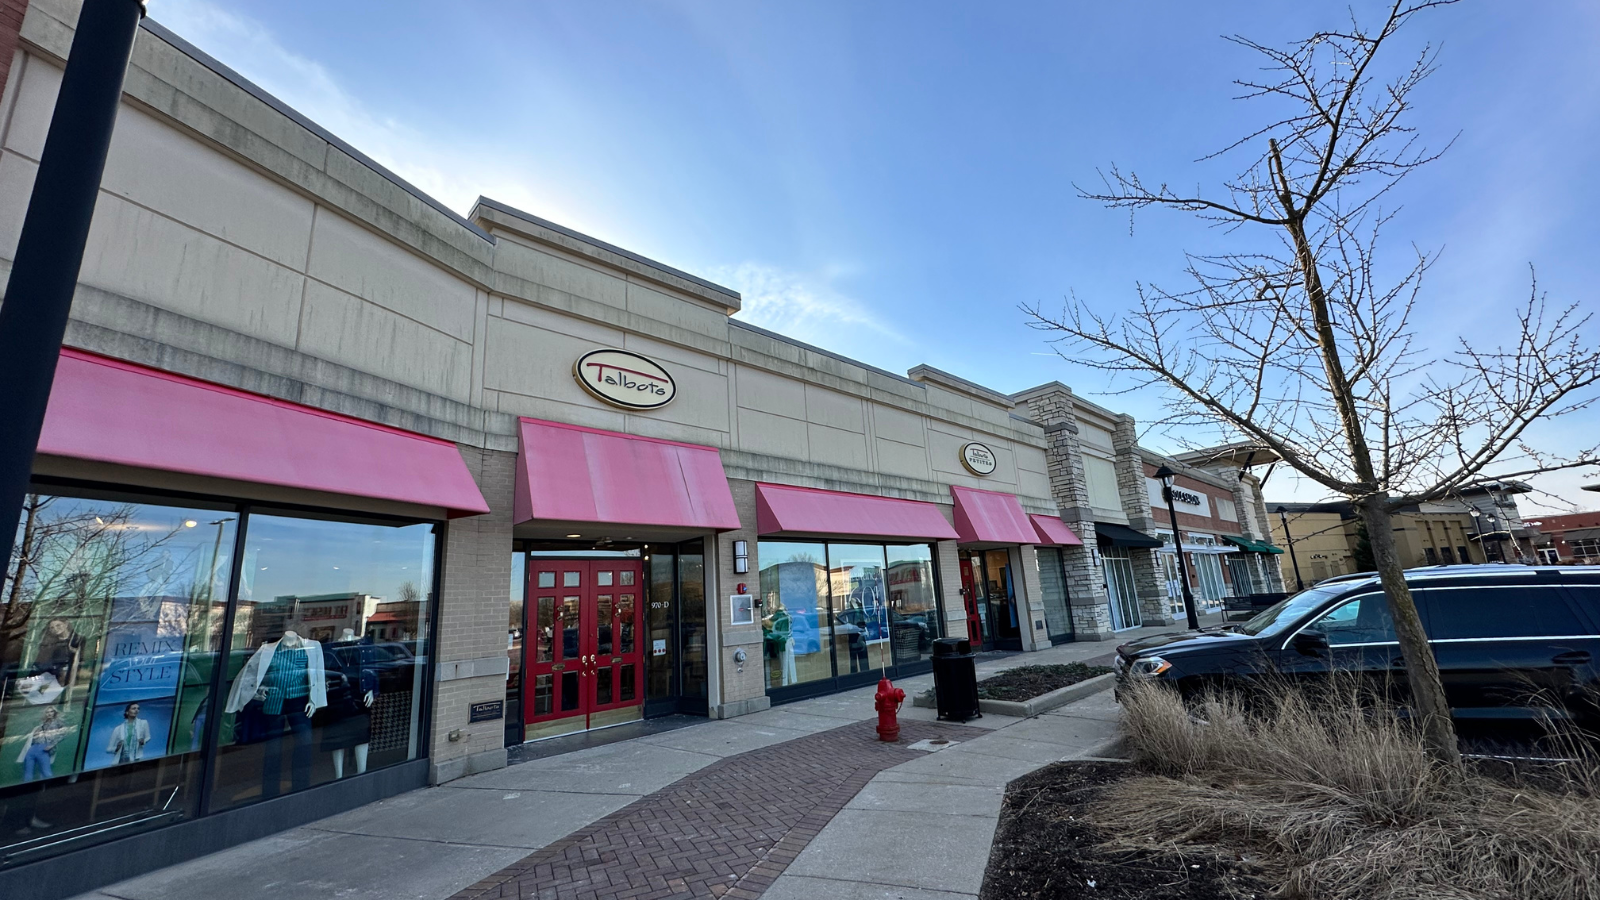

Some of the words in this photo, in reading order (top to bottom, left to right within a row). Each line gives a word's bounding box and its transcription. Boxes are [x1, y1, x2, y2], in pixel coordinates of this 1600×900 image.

[586, 362, 669, 396] Talbots
[969, 457, 992, 466] PETITES
[651, 601, 669, 609] 970-D
[114, 640, 176, 656] REMIX
[110, 666, 171, 684] STYLE
